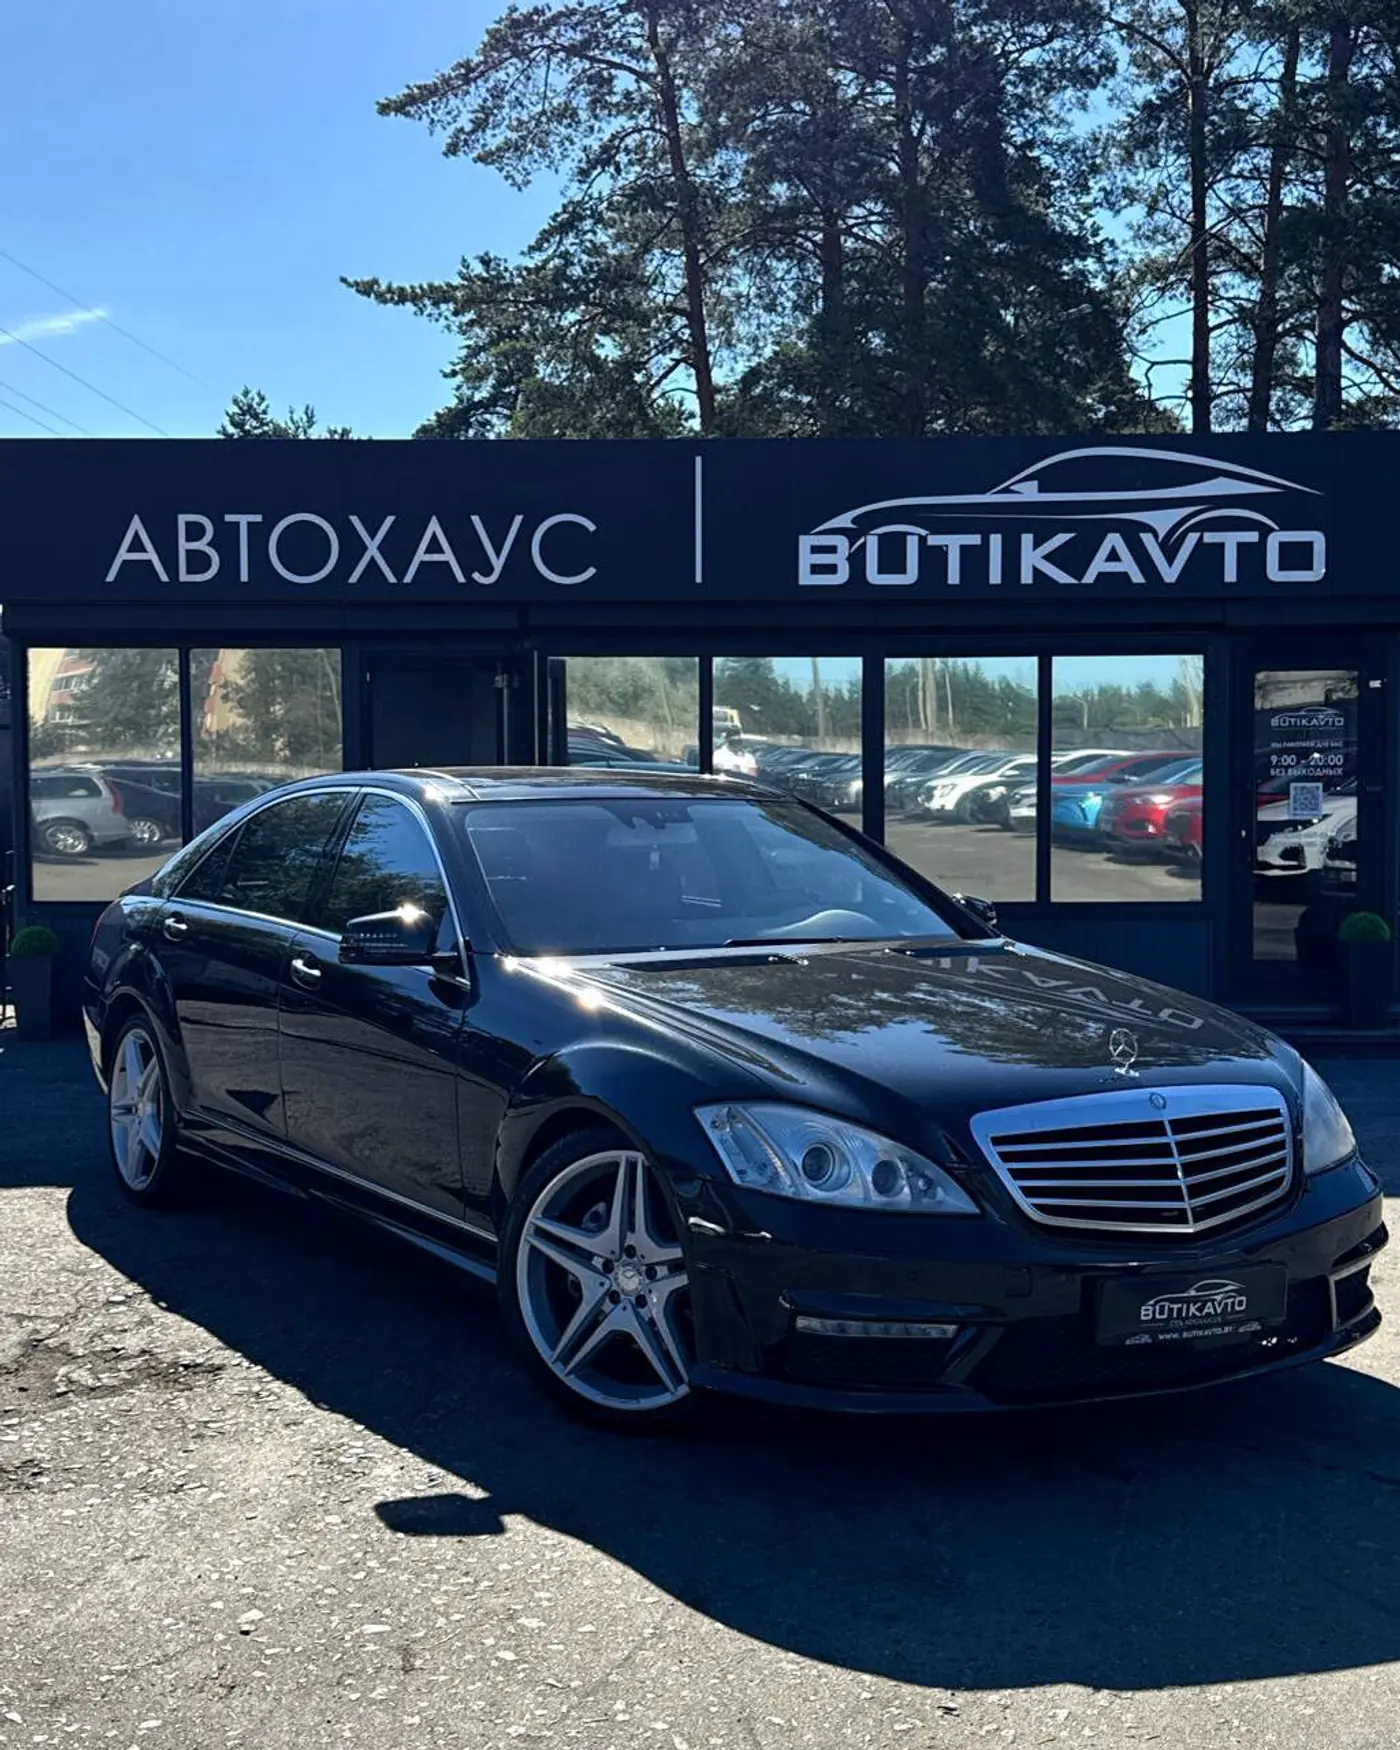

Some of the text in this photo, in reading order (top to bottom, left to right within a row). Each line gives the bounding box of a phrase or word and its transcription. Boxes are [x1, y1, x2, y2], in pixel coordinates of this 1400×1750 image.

[105, 512, 598, 585] АВТОХАУС
[797, 529, 1327, 586] BUTIKAVTO
[1270, 717, 1344, 727] BUTIKAVTO
[1270, 754, 1296, 766] 9:00
[1140, 1296, 1247, 1321] BUTIKAVTO
